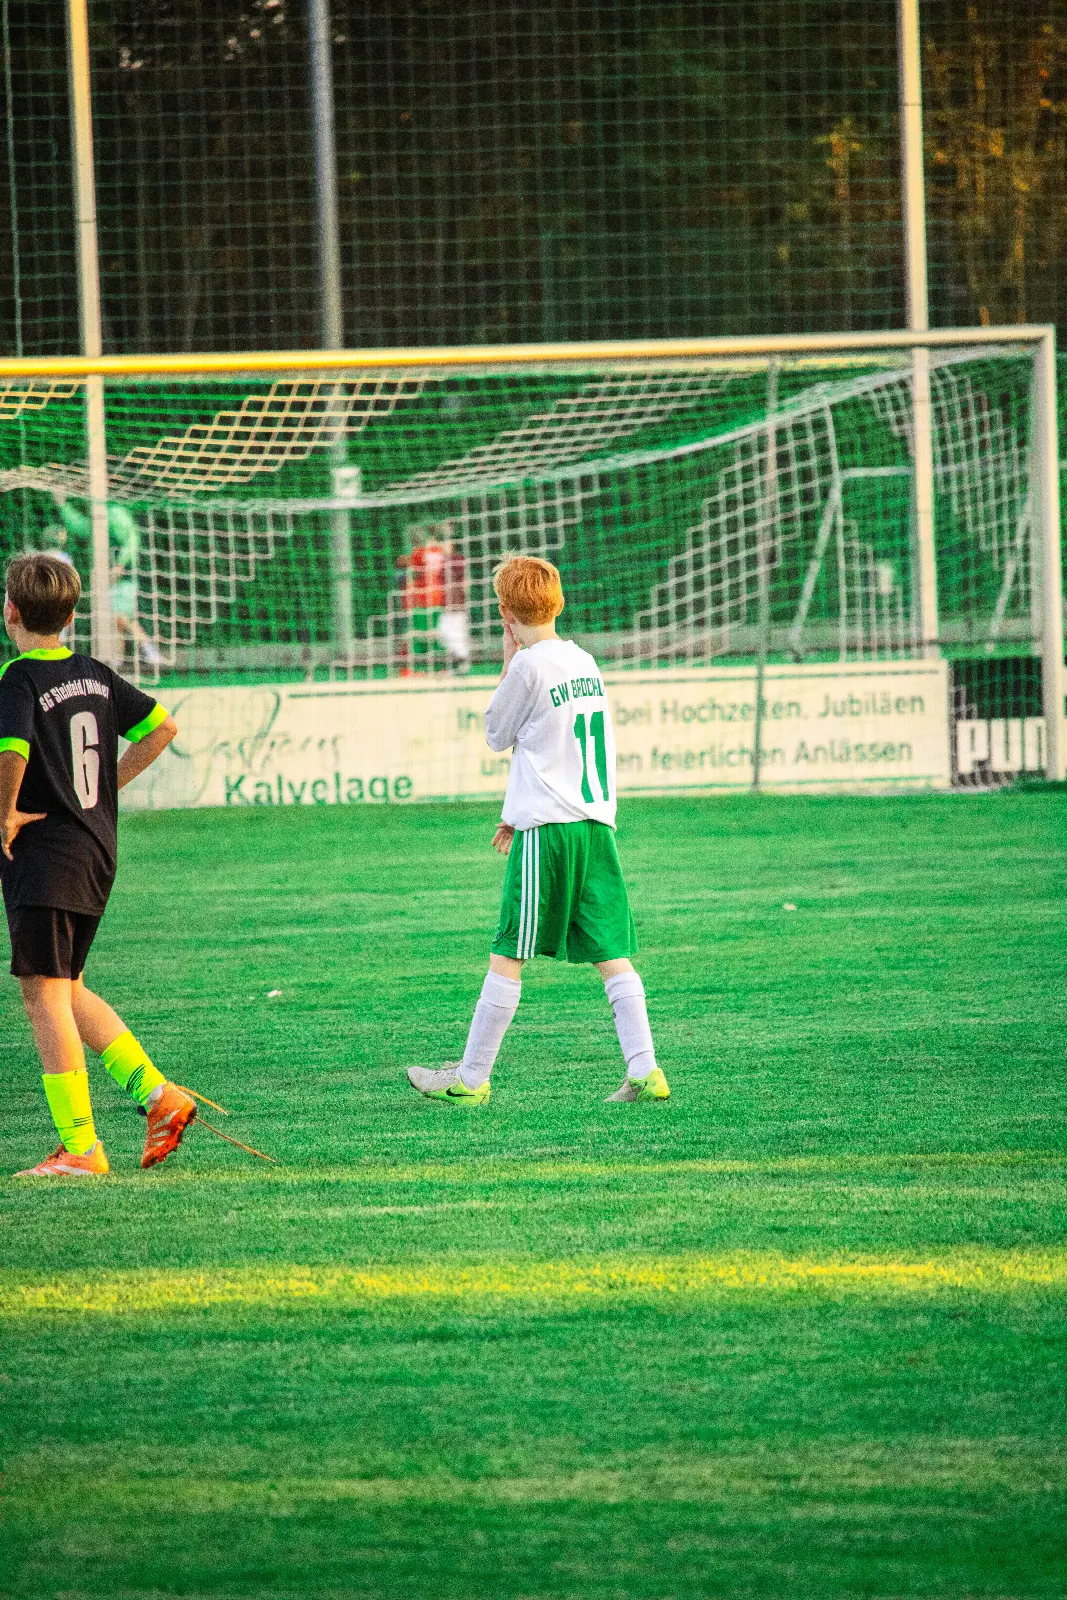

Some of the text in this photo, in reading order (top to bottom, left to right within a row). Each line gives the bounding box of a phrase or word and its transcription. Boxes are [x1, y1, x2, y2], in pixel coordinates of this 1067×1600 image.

[39, 692, 55, 712] SG
[549, 682, 570, 707] GW
[818, 691, 926, 719] Jubiläen
[70, 711, 99, 809] 6
[574, 711, 609, 803] 11
[794, 737, 913, 765] Anlässen
[225, 772, 414, 806] Kalvelage
